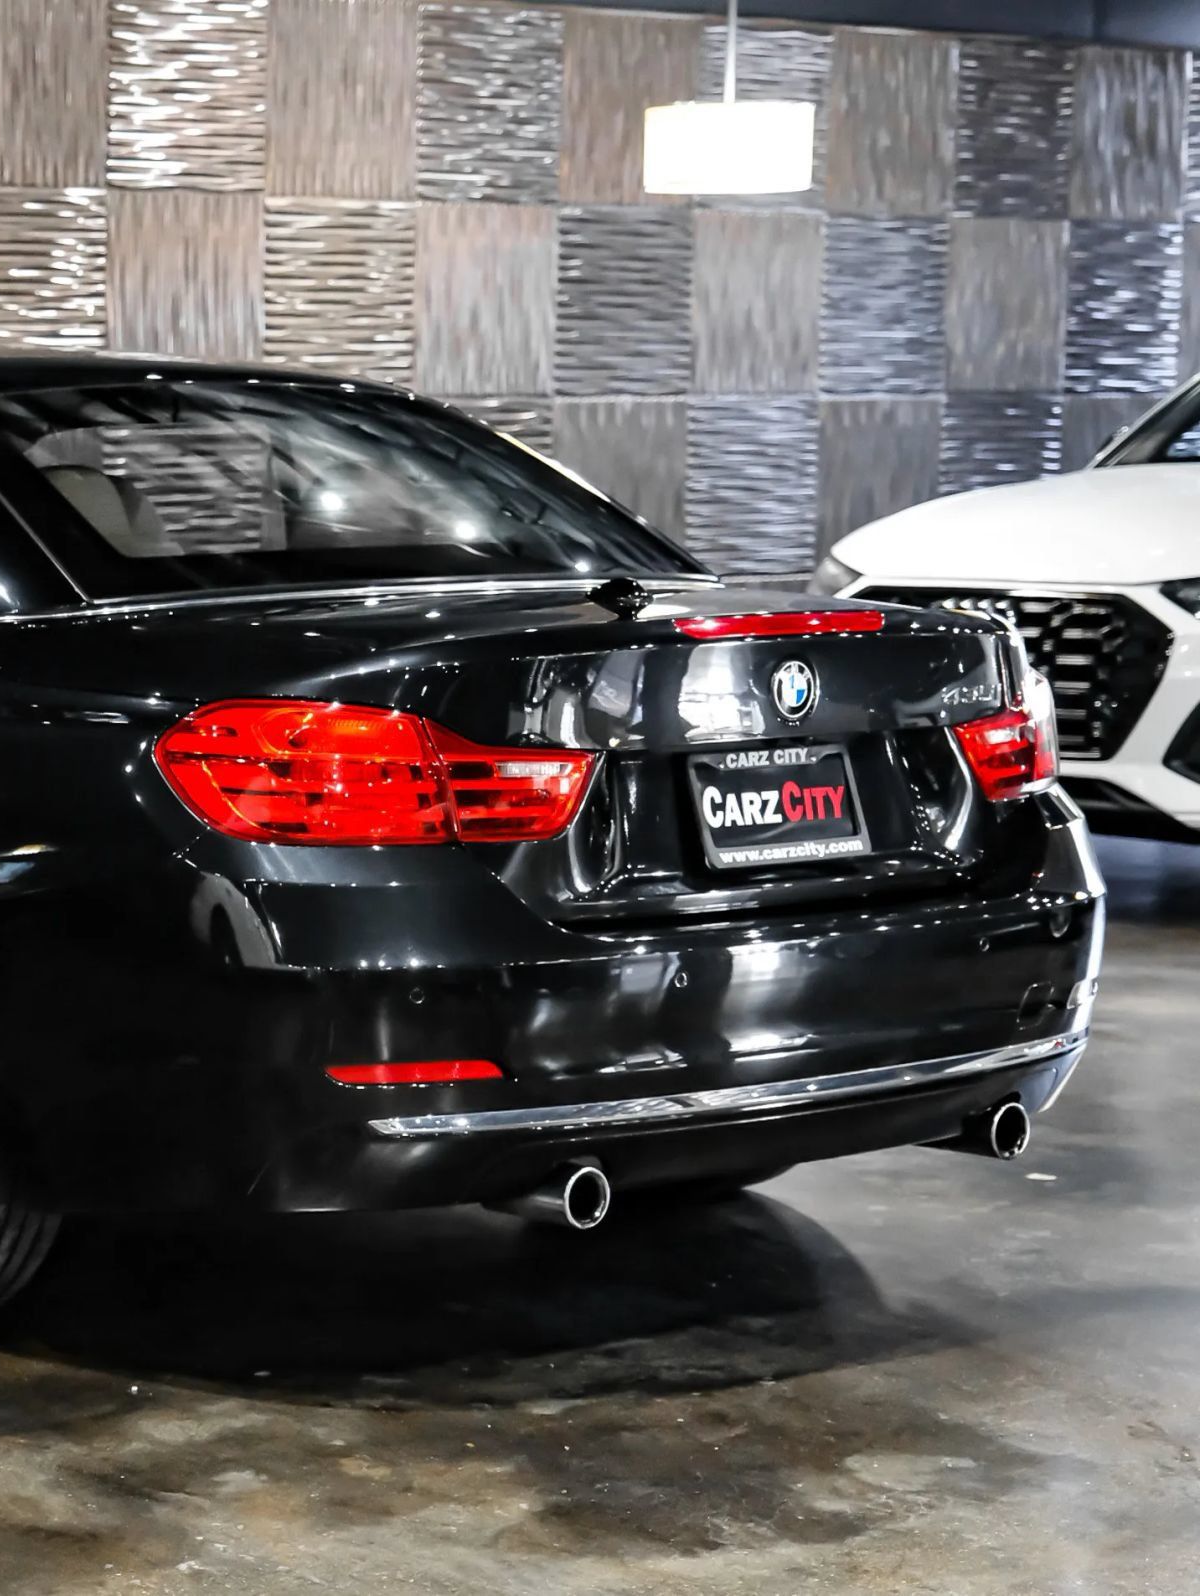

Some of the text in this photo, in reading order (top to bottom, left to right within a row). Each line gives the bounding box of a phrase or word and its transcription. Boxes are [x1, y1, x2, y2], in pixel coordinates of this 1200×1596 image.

[726, 748, 809, 768] CARZ CITY
[719, 840, 863, 863] www.carzcity.com
